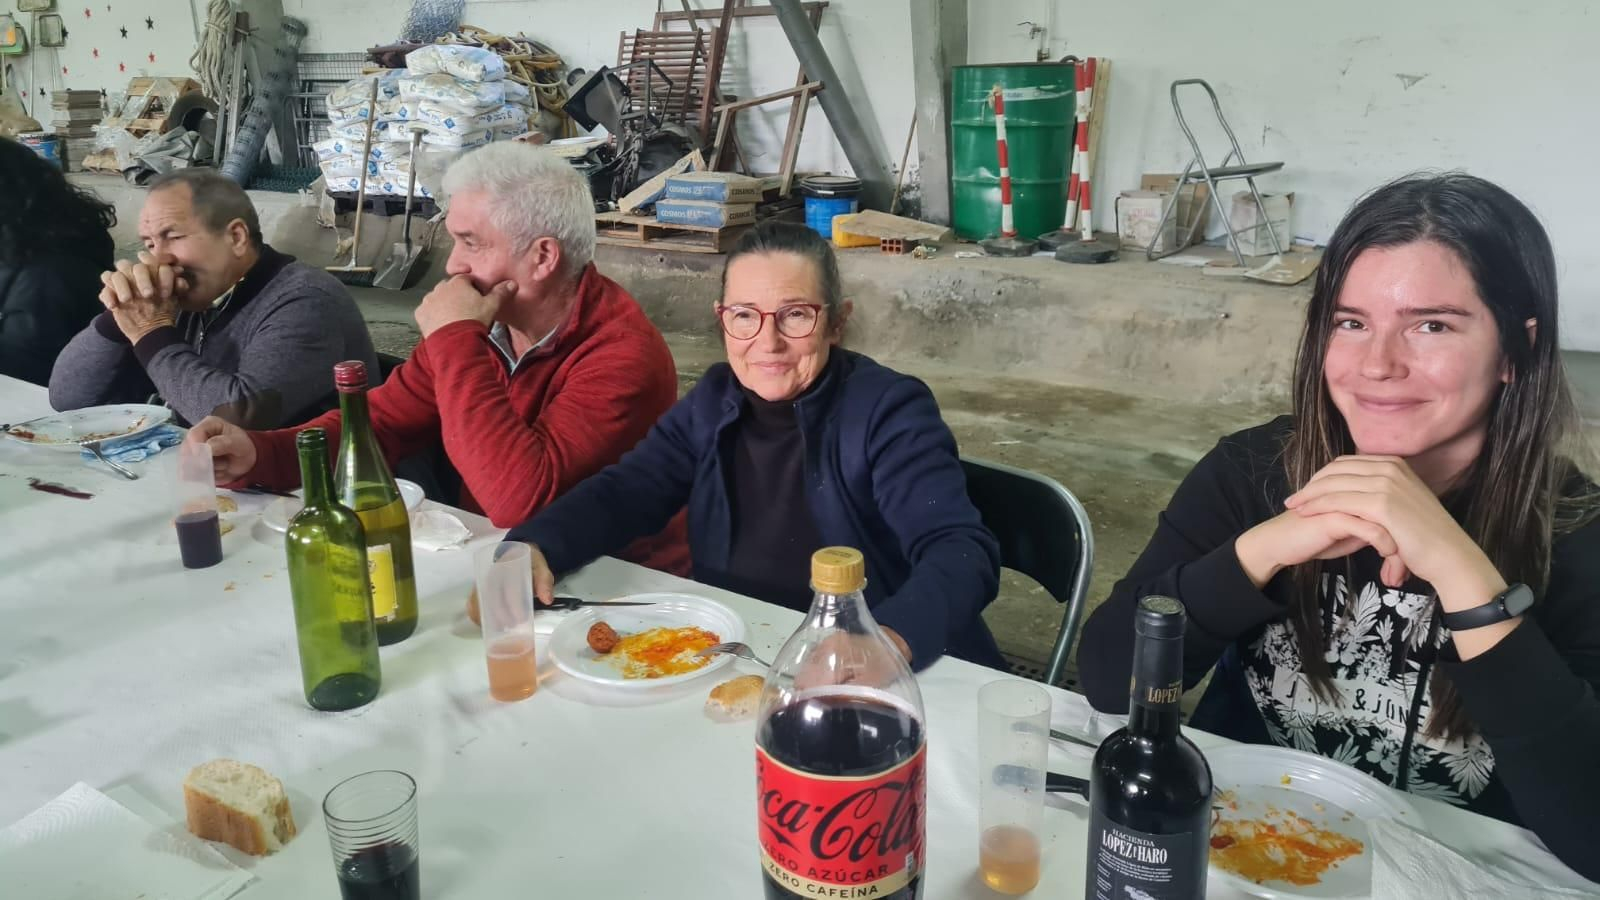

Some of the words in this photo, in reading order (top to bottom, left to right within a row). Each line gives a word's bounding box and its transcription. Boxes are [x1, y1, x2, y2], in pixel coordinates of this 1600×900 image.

[1148, 686, 1177, 704] LOPEZ
[1102, 829, 1133, 859] LOPEZ
[1137, 845, 1168, 865] HARO
[1112, 828, 1155, 847] HACIENDA
[763, 841, 799, 872] ZERO
[808, 863, 889, 883] AZÚCAR
[768, 861, 800, 888] ZERO
[806, 883, 879, 899] CAFEÍNA
